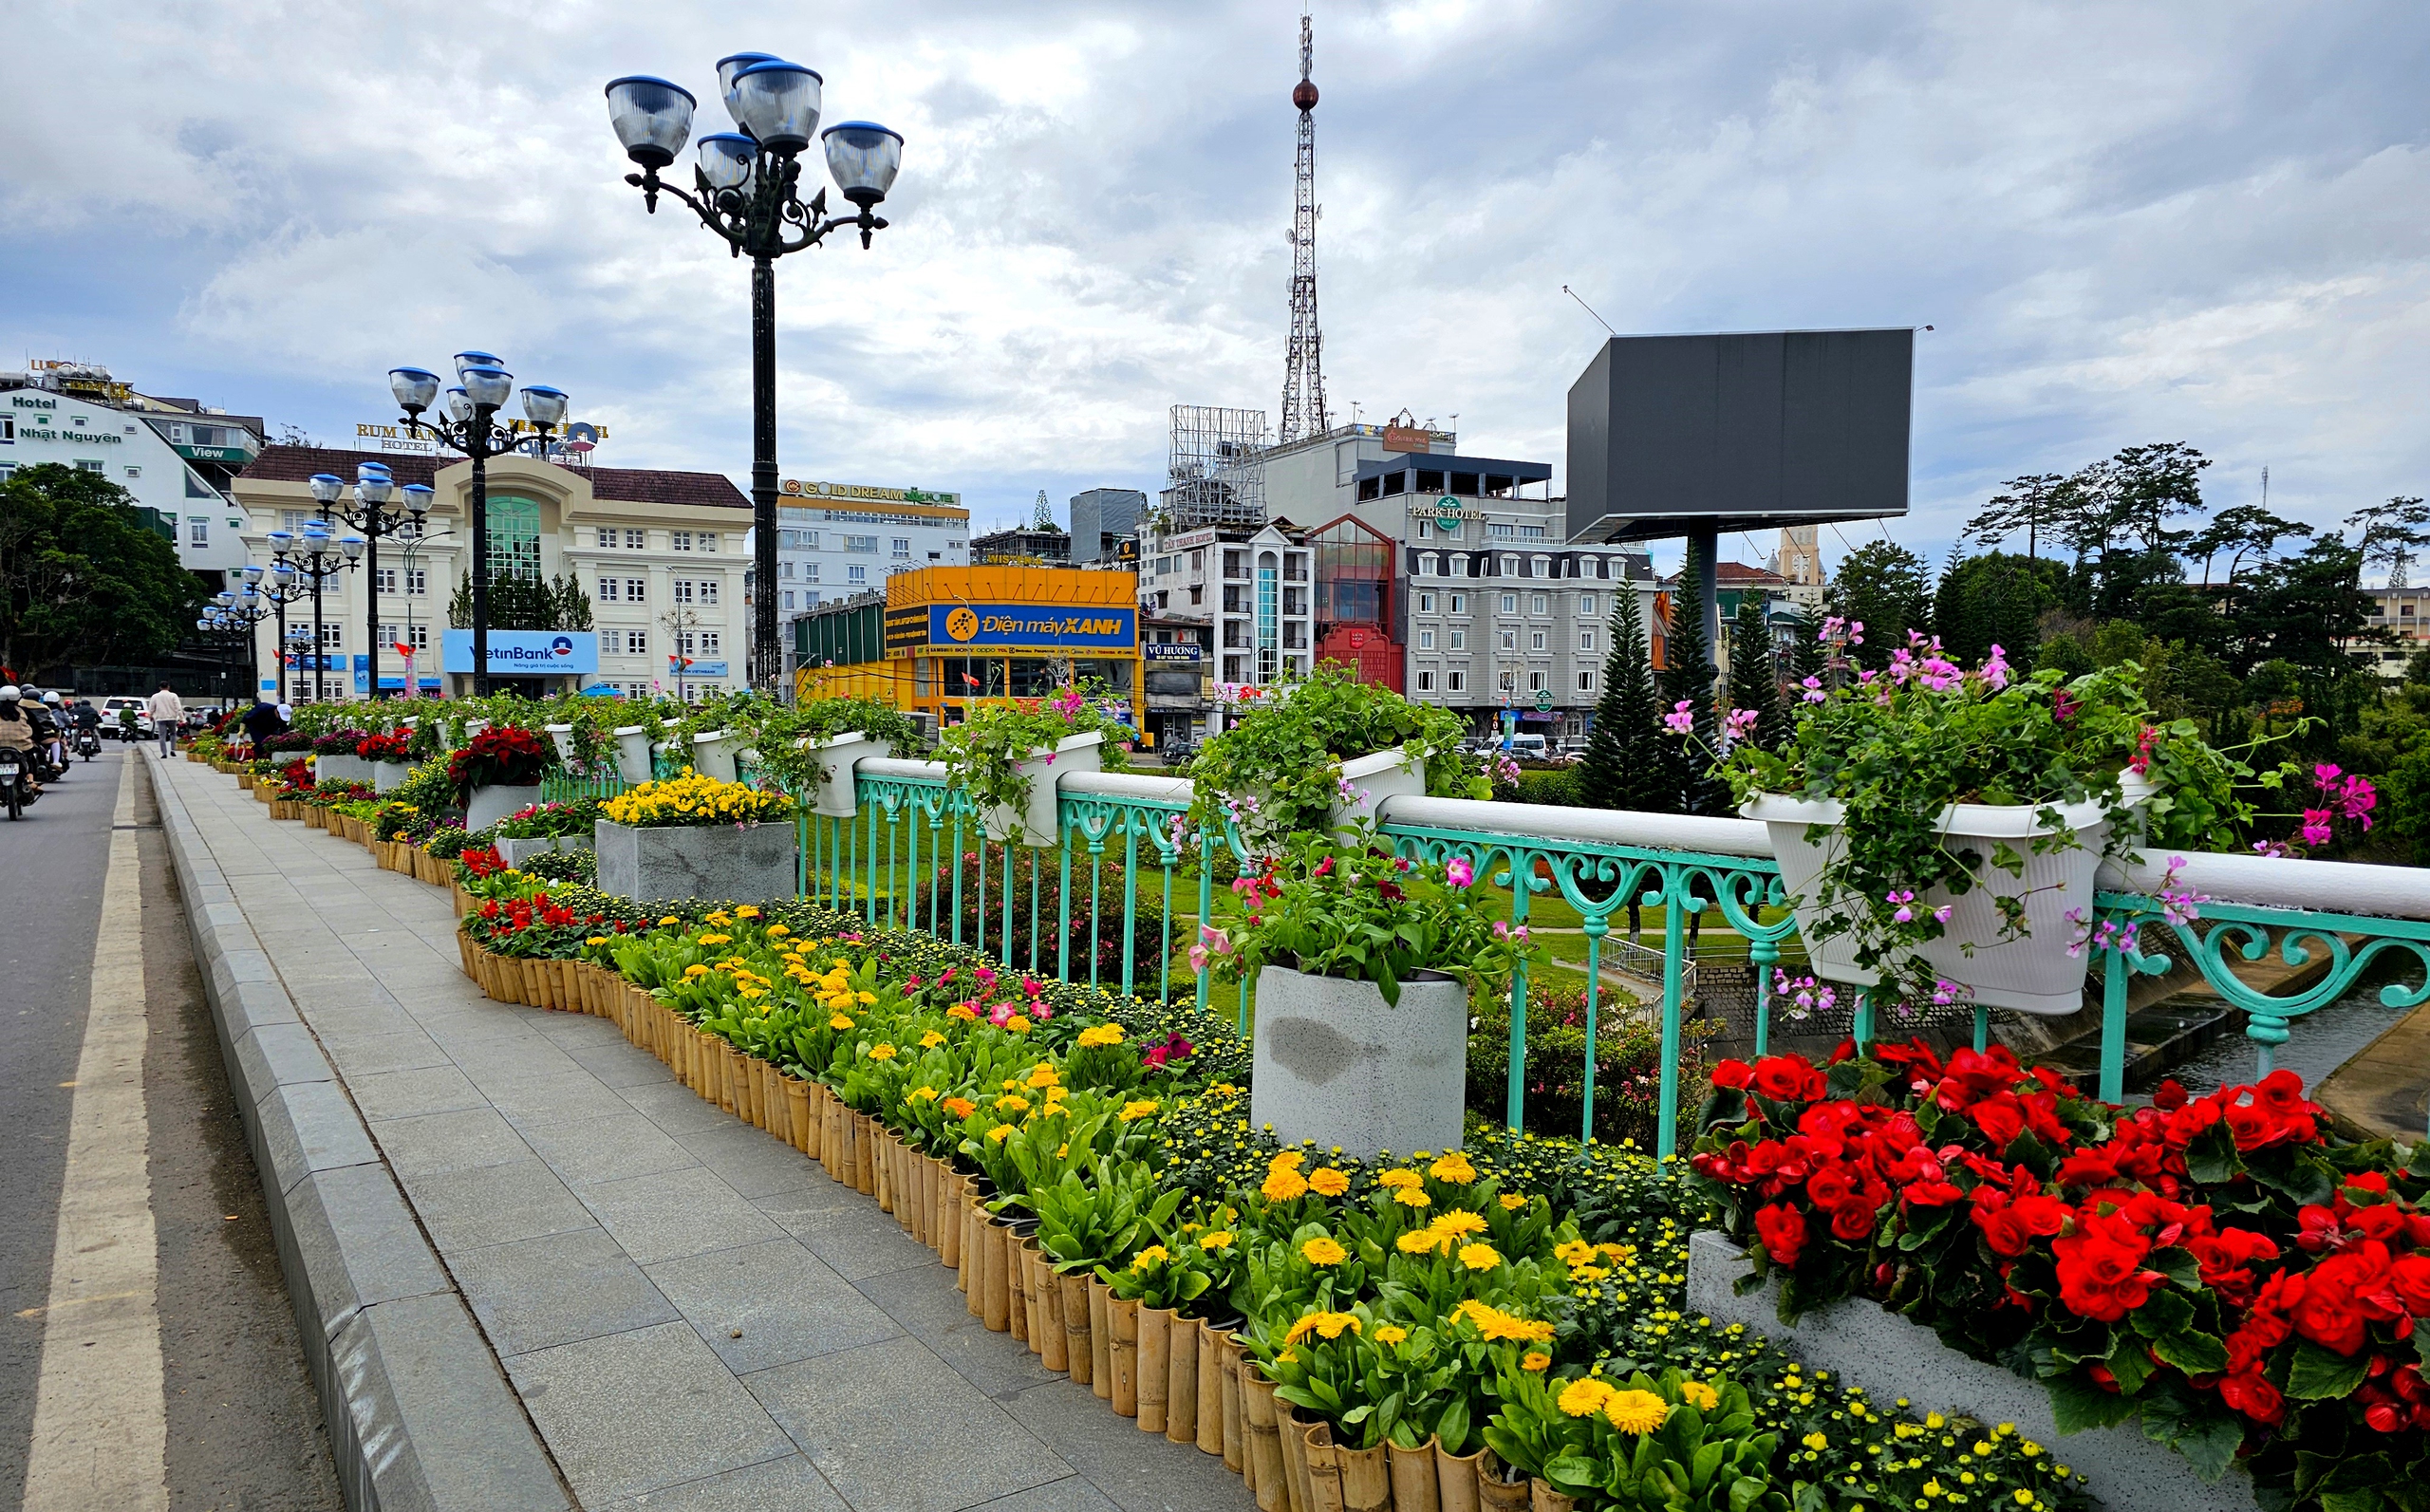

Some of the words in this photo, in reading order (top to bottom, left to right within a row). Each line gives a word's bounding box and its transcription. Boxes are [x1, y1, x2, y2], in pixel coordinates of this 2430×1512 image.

[12, 396, 57, 409] Hotel
[20, 427, 57, 441] Nhật
[63, 430, 122, 444] Nguyên
[356, 424, 397, 438] RUM
[191, 446, 224, 458] View
[382, 439, 433, 452] HOTEL
[805, 481, 848, 495] GOLD
[850, 485, 903, 500] DREAM
[925, 492, 955, 504] HOTEL
[1412, 506, 1443, 518] PARK
[1447, 508, 1486, 520] HOTEL
[981, 615, 1024, 636] Điện
[469, 645, 553, 660] etinBank
[1148, 644, 1162, 655] VŨ
